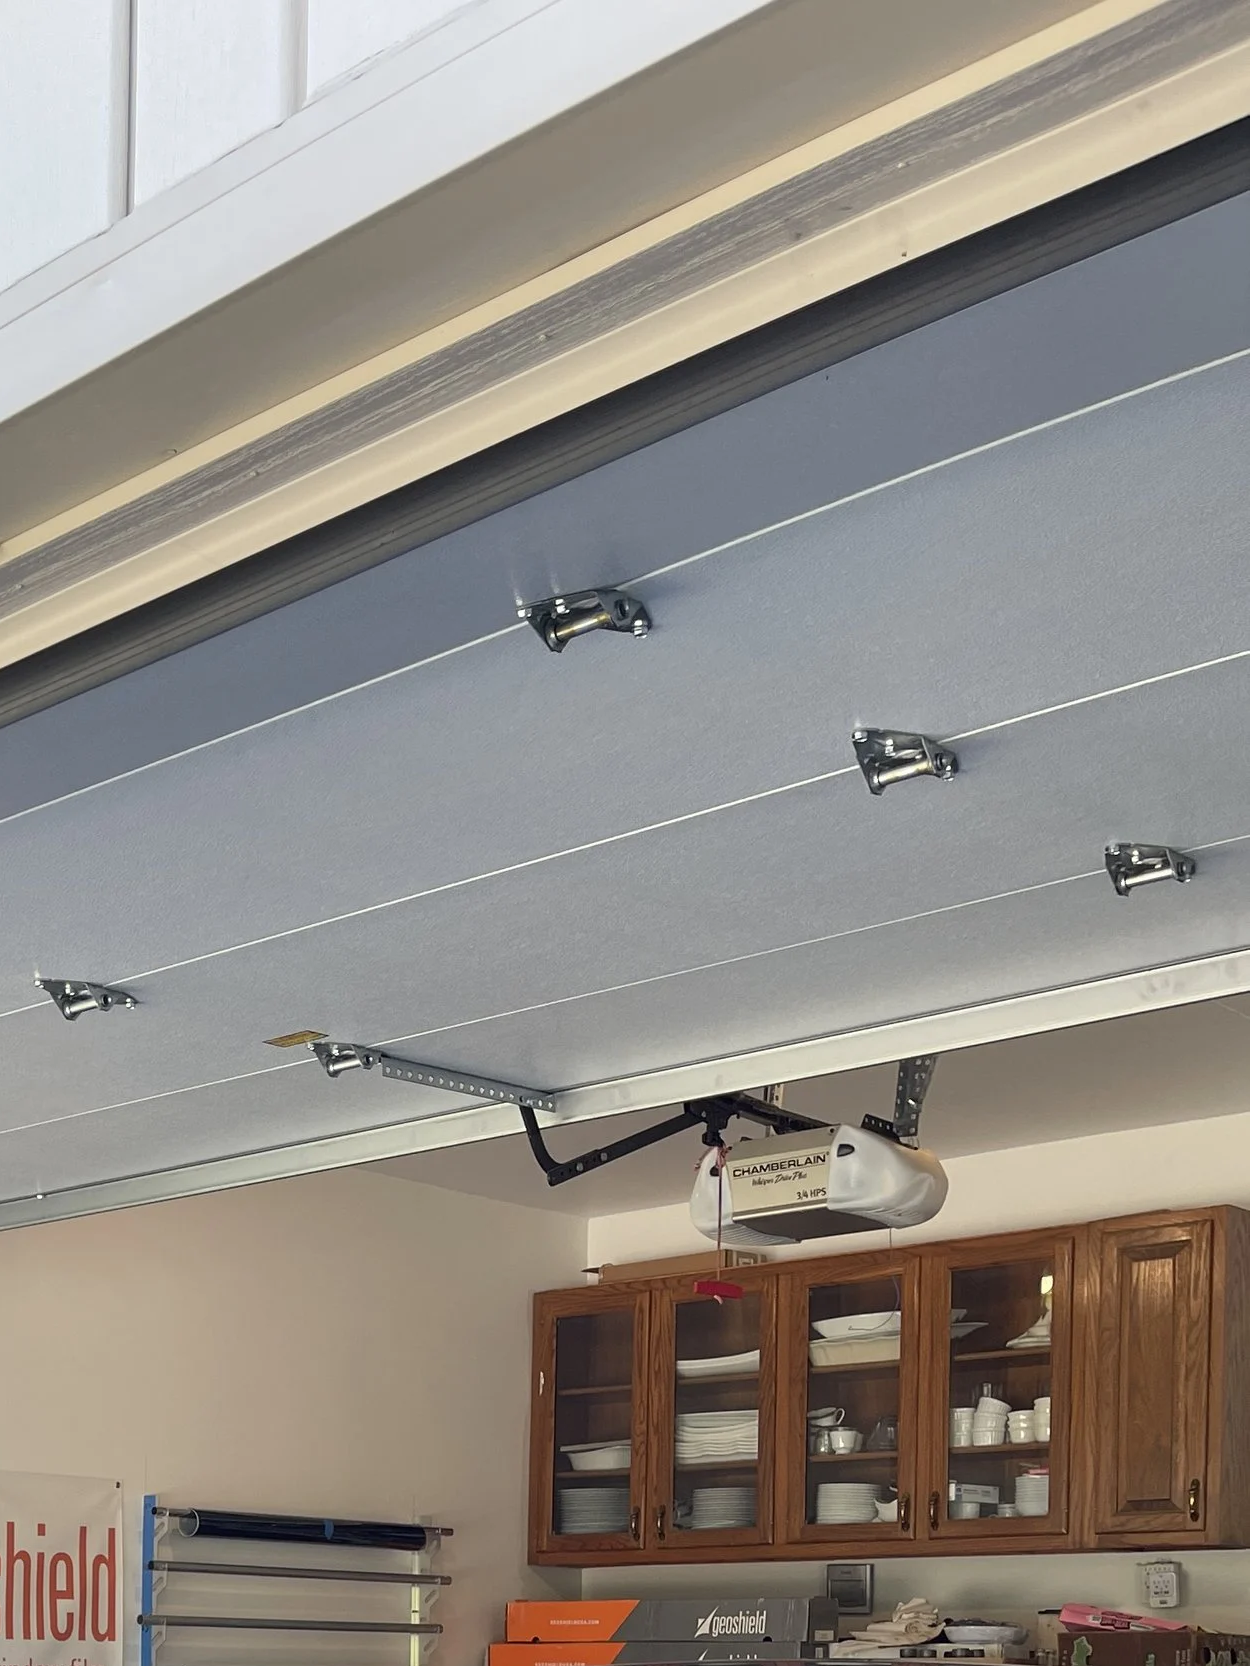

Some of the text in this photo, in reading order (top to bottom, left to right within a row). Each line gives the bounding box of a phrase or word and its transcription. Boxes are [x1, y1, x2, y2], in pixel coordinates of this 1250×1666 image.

[733, 1154, 826, 1178] CHAMBERLAIN
[796, 1187, 827, 1200] 3/4 HPS
[712, 1610, 767, 1637] geoshield
